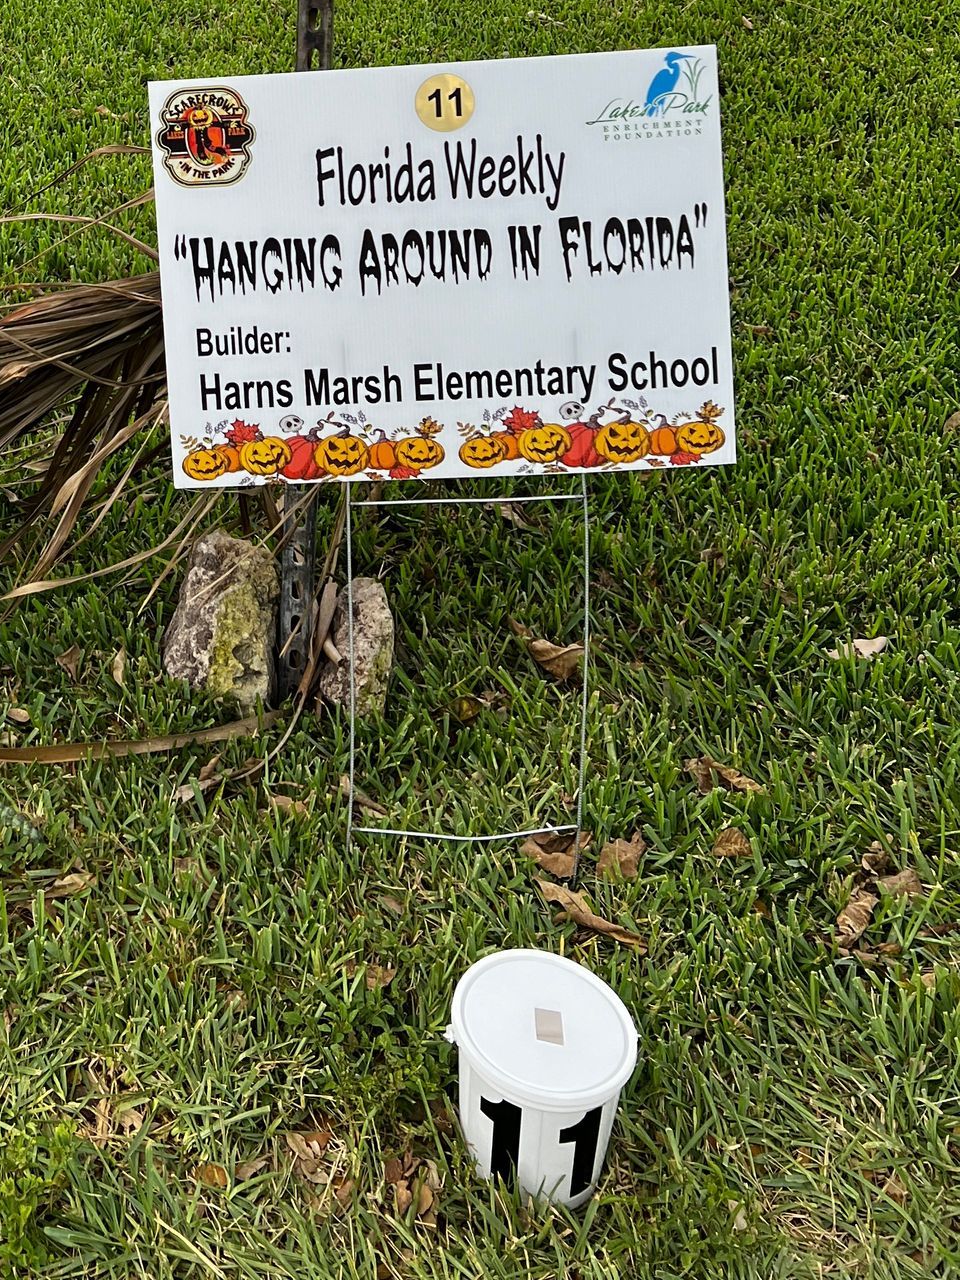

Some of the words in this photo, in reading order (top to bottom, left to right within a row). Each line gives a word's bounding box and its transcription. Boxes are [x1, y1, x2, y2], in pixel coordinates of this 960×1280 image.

[169, 93, 240, 119] SCARECROWS
[427, 87, 463, 118] 11
[585, 98, 653, 125] Lakes
[652, 92, 713, 116] Park
[602, 119, 703, 133] ENRICHMENT
[603, 128, 703, 141] FOUNDATION
[180, 162, 191, 174] IN
[192, 168, 211, 179] THE
[211, 160, 234, 178] PARK
[315, 142, 437, 208] Florida
[443, 133, 567, 211] Weekly
[358, 228, 494, 297] AROUND
[506, 224, 543, 282] IN
[195, 325, 292, 358] Builder:
[199, 372, 295, 411] Harns
[303, 365, 403, 407] Marsh
[413, 360, 597, 404] Elementary
[607, 346, 720, 392] School
[480, 1095, 603, 1198] 11
